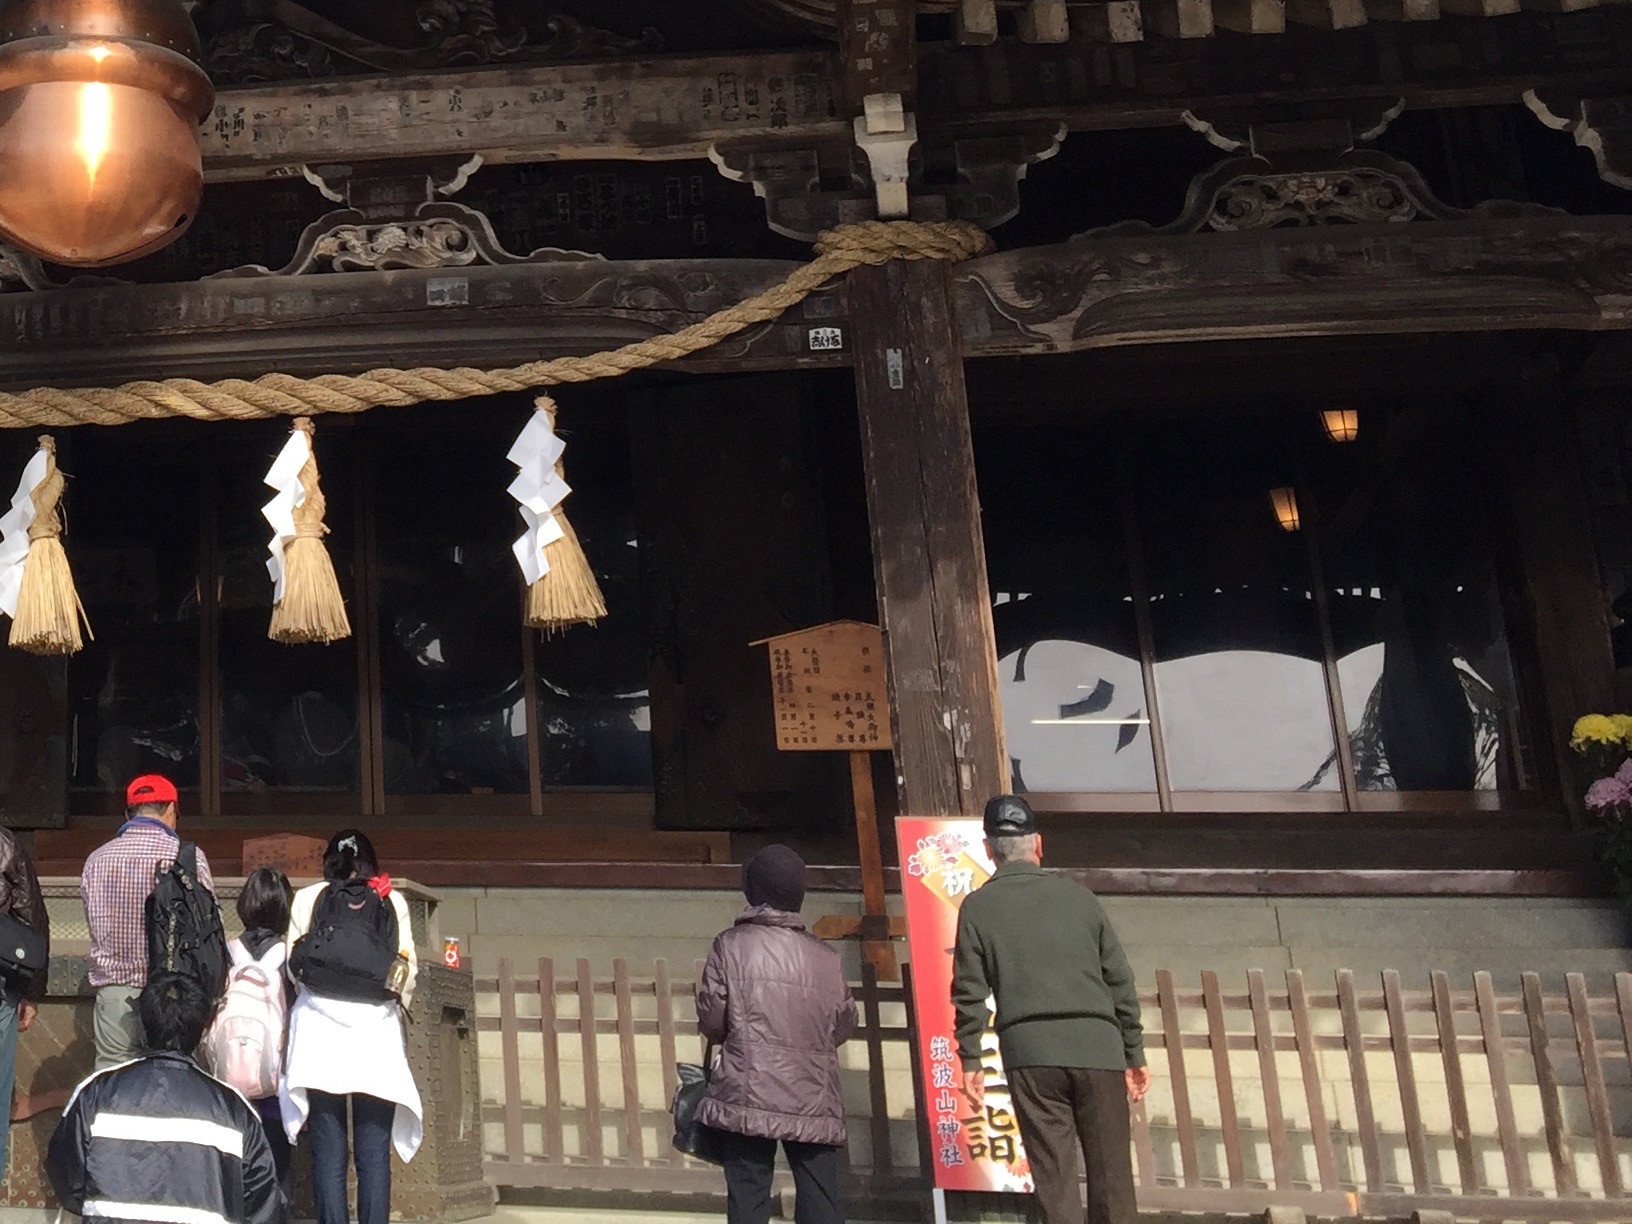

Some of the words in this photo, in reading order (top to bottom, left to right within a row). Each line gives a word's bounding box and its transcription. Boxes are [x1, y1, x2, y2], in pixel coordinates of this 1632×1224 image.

[941, 866, 978, 897] 祝
[929, 1036, 964, 1167] 筑波山神社
